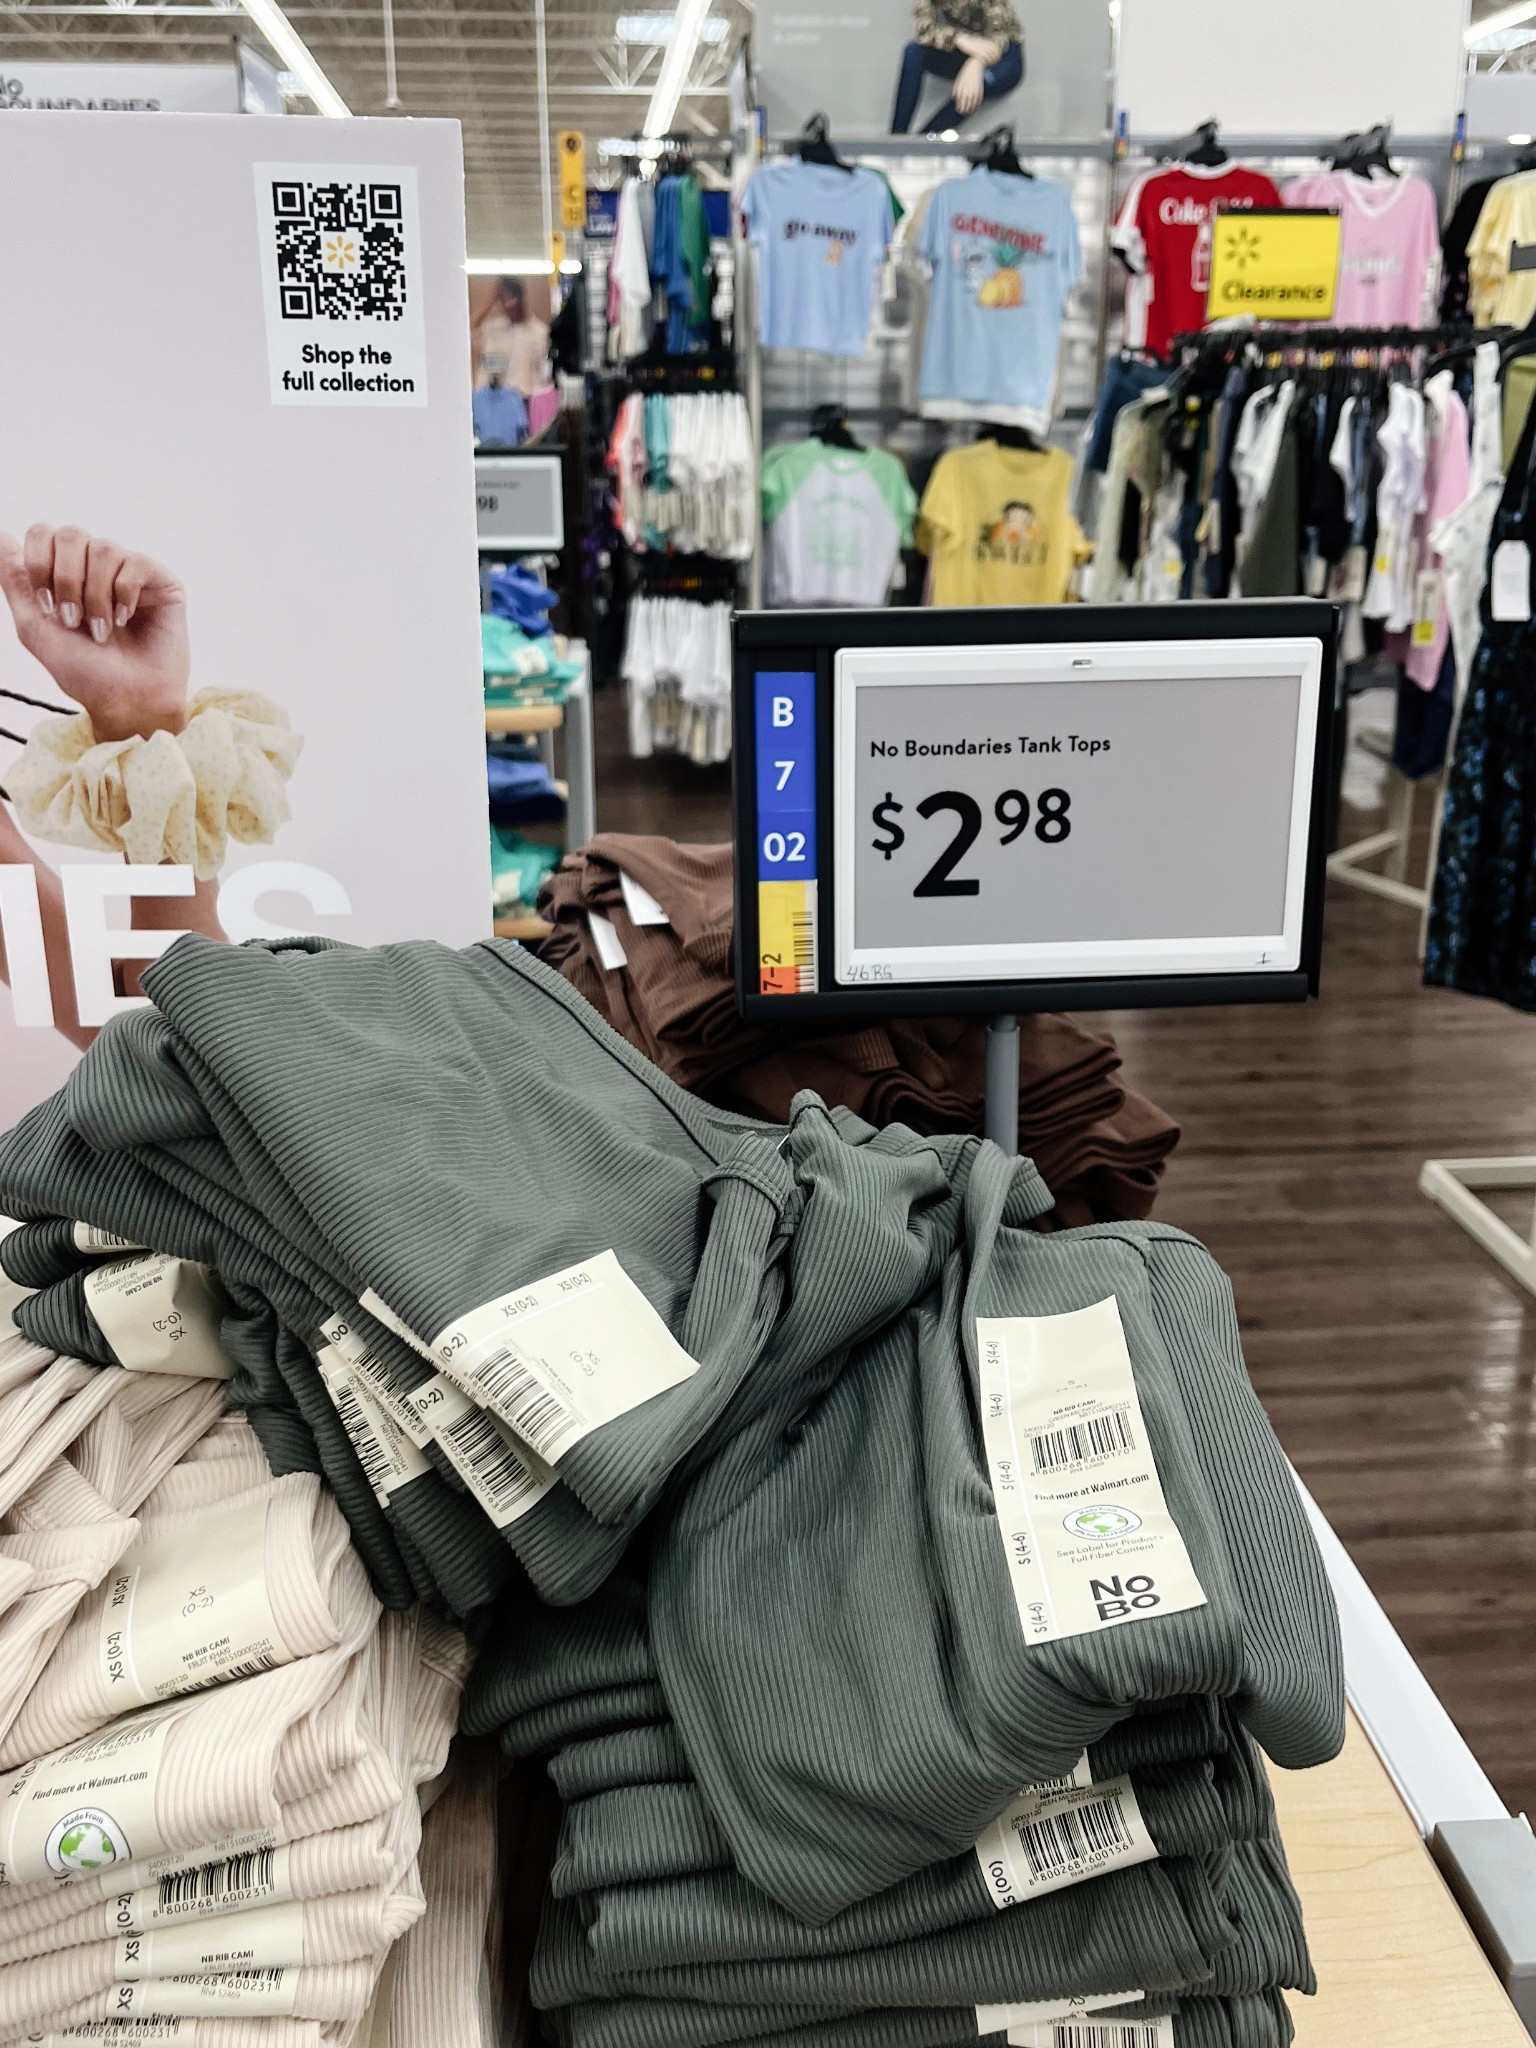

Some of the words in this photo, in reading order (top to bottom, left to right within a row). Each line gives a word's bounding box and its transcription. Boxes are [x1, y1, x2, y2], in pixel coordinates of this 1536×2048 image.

[0, 75, 23, 96] O
[0, 97, 161, 111] OUNDARIES
[1222, 279, 1328, 305] Clearance
[302, 343, 354, 370] Shop
[359, 344, 392, 365] the
[282, 370, 315, 391] full
[319, 371, 415, 392] collection
[772, 696, 795, 728] B
[870, 741, 899, 758] No
[905, 738, 1012, 757] Boundaries
[1018, 736, 1062, 753] Tank
[1068, 734, 1112, 754] Tops
[773, 760, 796, 792] 7
[762, 831, 806, 863] 02
[557, 1279, 573, 1293] XS
[152, 1311, 182, 1332] (0-2)
[500, 1304, 516, 1318] XS
[169, 1326, 188, 1341] XS
[328, 1318, 350, 1346] (00
[354, 1364, 386, 1397] 800268
[387, 1399, 419, 1432] 600156
[415, 1387, 445, 1414] (0-2)
[1077, 1399, 1096, 1408] CAMI
[442, 1433, 471, 1469] 800268
[471, 1473, 500, 1509] 600163
[1042, 1460, 1082, 1476] 800268
[1089, 1448, 1130, 1463] 600170
[1035, 1493, 1055, 1501] Find
[1056, 1490, 1079, 1501] more
[1080, 1486, 1090, 1496] at
[1090, 1472, 1150, 1494] Walmart.com
[1056, 1549, 1075, 1558] See
[1075, 1543, 1104, 1555] Label
[1105, 1540, 1119, 1549] for
[1071, 1554, 1088, 1564] Full
[1089, 1550, 1114, 1561] Fiber
[1116, 1542, 1154, 1556] Content
[189, 1585, 207, 1600] XS
[181, 1594, 215, 1618] (0-2)
[106, 1631, 122, 1660] (0-2)
[182, 1653, 194, 1663] NB
[194, 1647, 209, 1658] RIB
[208, 1636, 231, 1651] CAMI
[109, 1660, 125, 1684] XS
[187, 1655, 209, 1671] FRUIT
[8, 1779, 26, 1798] XS
[32, 1787, 53, 1801] Find
[52, 1784, 76, 1797] more
[76, 1781, 87, 1791] at
[88, 1770, 149, 1790] Walmart.com
[1039, 1792, 1051, 1801] NB
[62, 1813, 84, 1829] Made
[84, 1811, 105, 1825] From
[1028, 1878, 1035, 1886] 8
[1040, 1860, 1081, 1882] 800268
[1088, 1841, 1129, 1864] 600156
[988, 1860, 1013, 1894] (00)
[116, 1892, 134, 1929] (0-2)
[152, 1908, 159, 1918] 8
[166, 1896, 213, 1915] 800268
[221, 1885, 267, 1904] 600231
[124, 1940, 141, 1962] XS
[201, 1954, 214, 1964] NB
[215, 1952, 230, 1962] RIB
[230, 1949, 255, 1960] CAMI
[226, 1978, 273, 1993] 600231
[116, 1986, 134, 2010] XS
[75, 2026, 119, 2038] 800268
[127, 2026, 171, 2039] 600231
